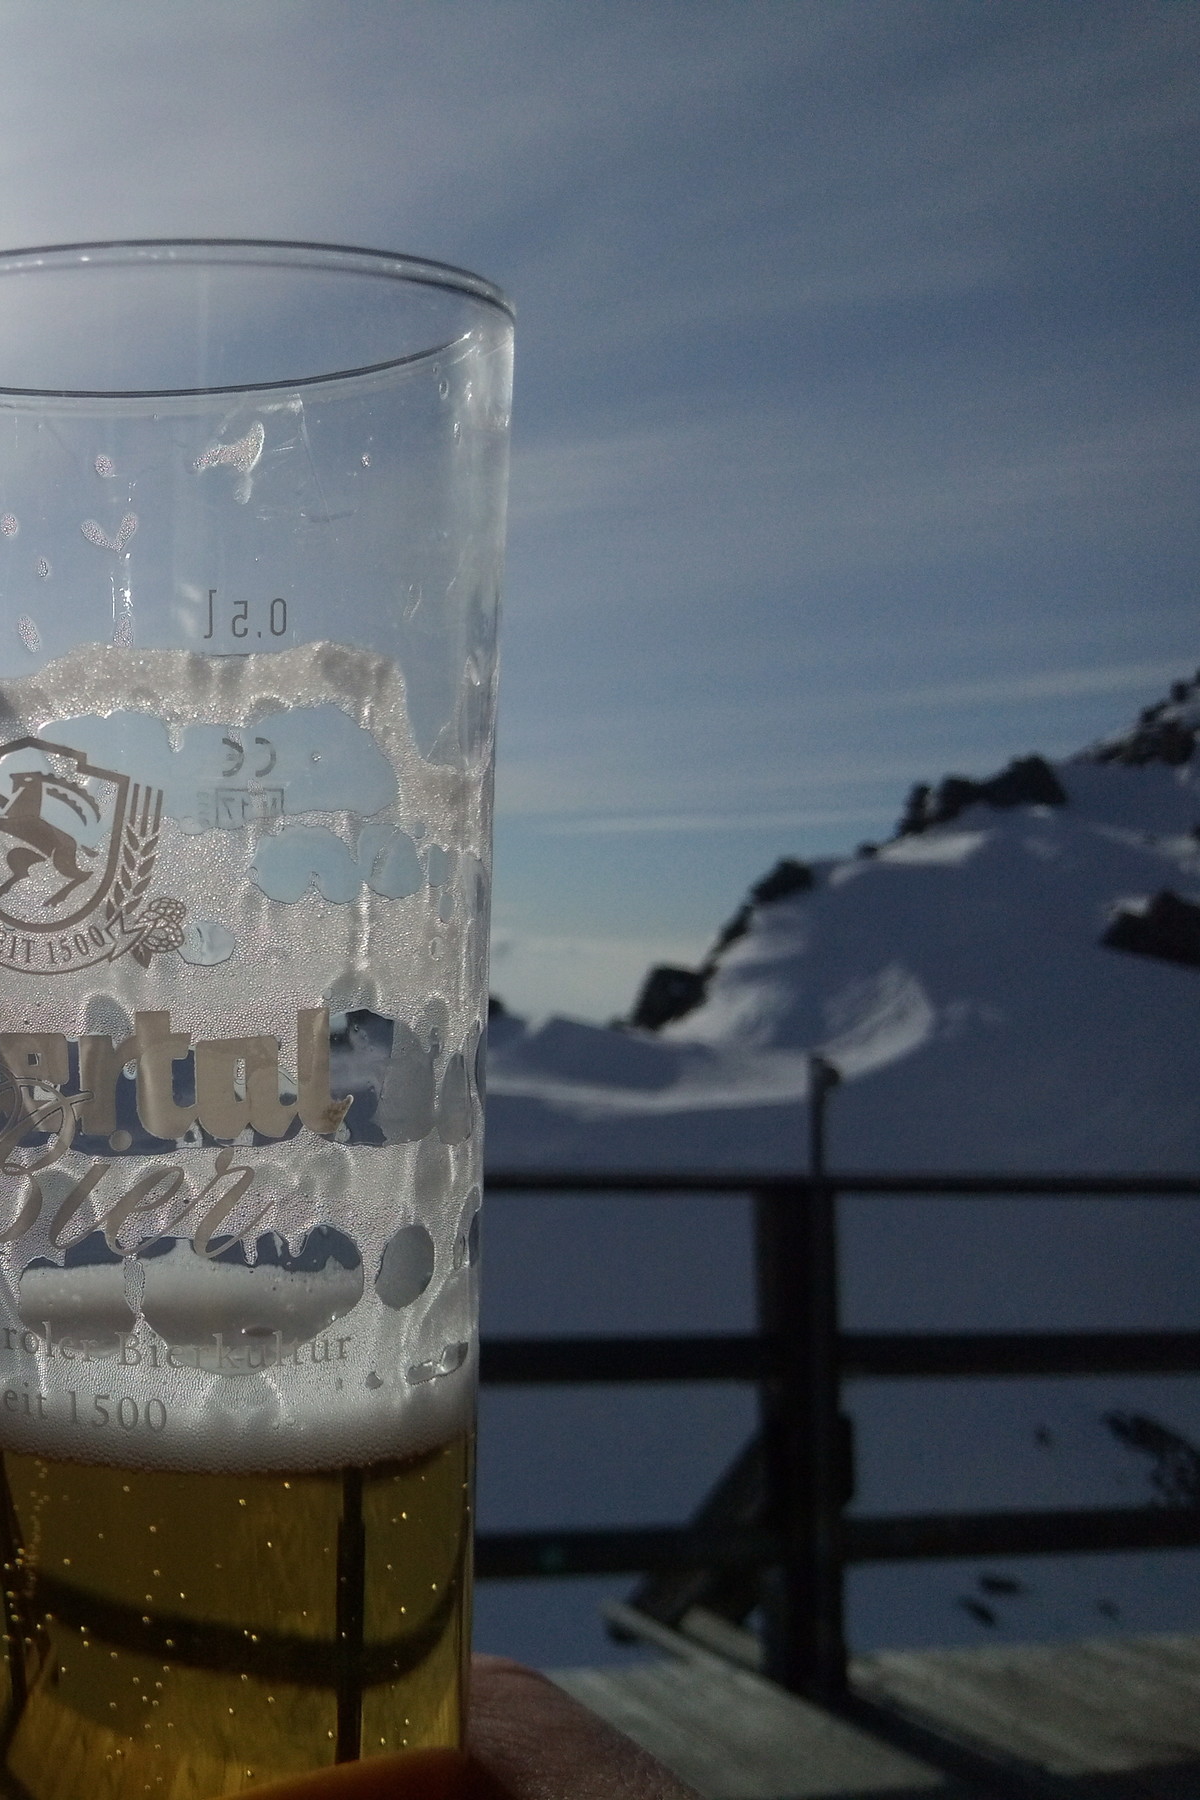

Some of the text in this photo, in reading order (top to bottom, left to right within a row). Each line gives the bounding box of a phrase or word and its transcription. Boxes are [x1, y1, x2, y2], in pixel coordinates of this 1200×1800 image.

[47, 924, 106, 965] 1500
[114, 1330, 352, 1370] Bierkultur
[67, 1390, 169, 1433] 1500
